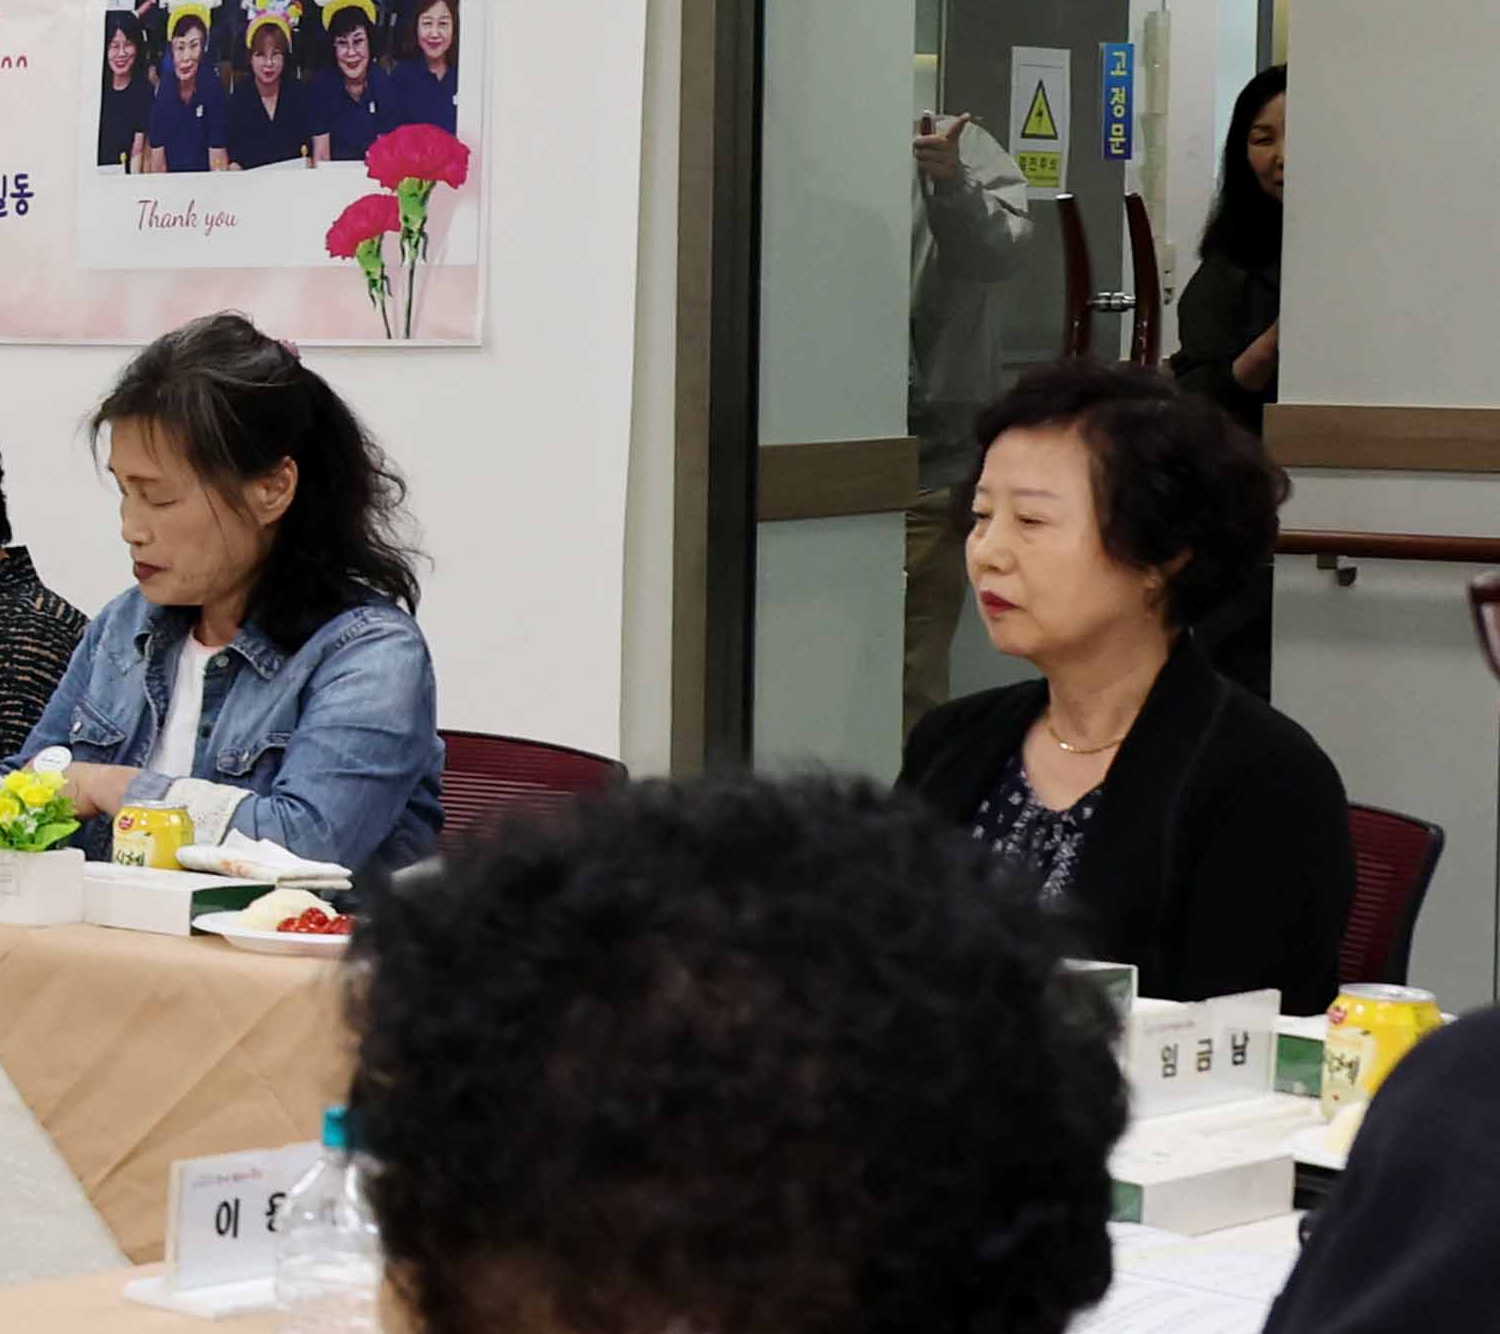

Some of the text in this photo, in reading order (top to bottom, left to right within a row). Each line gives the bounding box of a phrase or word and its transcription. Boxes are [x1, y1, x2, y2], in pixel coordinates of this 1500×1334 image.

[1109, 50, 1128, 156] 고정문
[138, 199, 238, 237] Thank you
